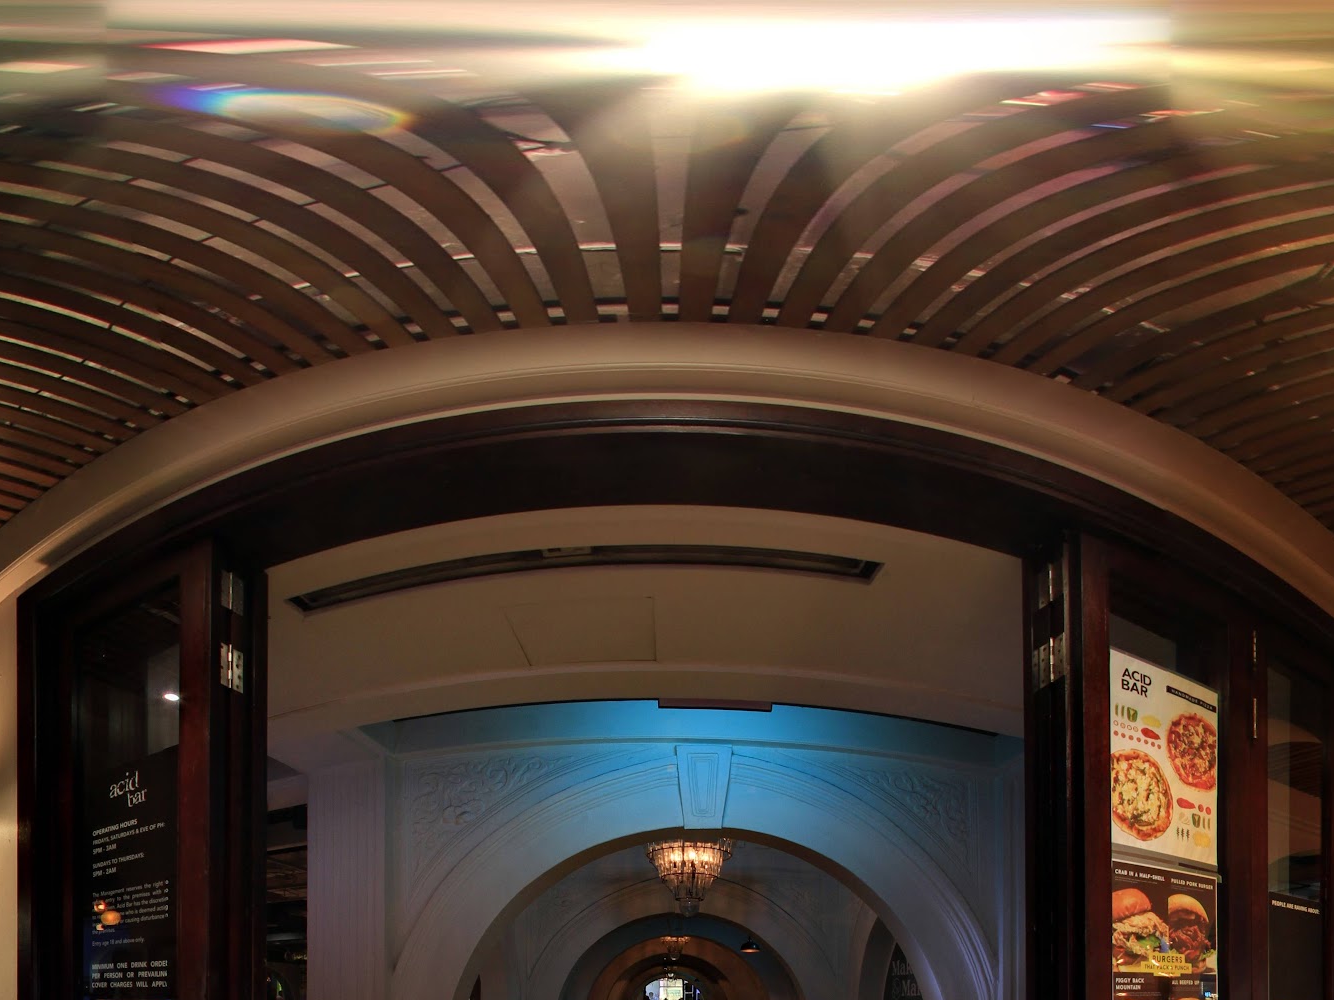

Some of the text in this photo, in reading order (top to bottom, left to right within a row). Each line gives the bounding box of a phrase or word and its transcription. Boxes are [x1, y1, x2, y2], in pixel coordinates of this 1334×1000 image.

[1122, 668, 1152, 687] ACID
[1121, 678, 1148, 698] BAR
[1171, 688, 1214, 711] HANDMADE PIZZA
[109, 770, 140, 799] acid
[127, 789, 147, 808] bar
[92, 818, 138, 837] OPERATING HOURS
[110, 829, 135, 841] SATURDAYS
[92, 846, 103, 856] 5PM
[92, 860, 111, 870] SUNDAYS
[118, 852, 145, 864] THURSDAYS:
[92, 870, 103, 878] 5PM
[1114, 868, 1127, 876] CRAB
[1139, 872, 1165, 882] HALF-SHELL
[100, 887, 125, 897] Management
[126, 884, 143, 892] reserves
[1171, 878, 1186, 886] PULLED
[1186, 880, 1198, 888] PORK
[1198, 882, 1214, 890] BURGER
[131, 890, 151, 899] premises
[1271, 899, 1286, 908] PEOPLE
[1152, 955, 1183, 963] BURGERS
[104, 971, 123, 979] PERSON
